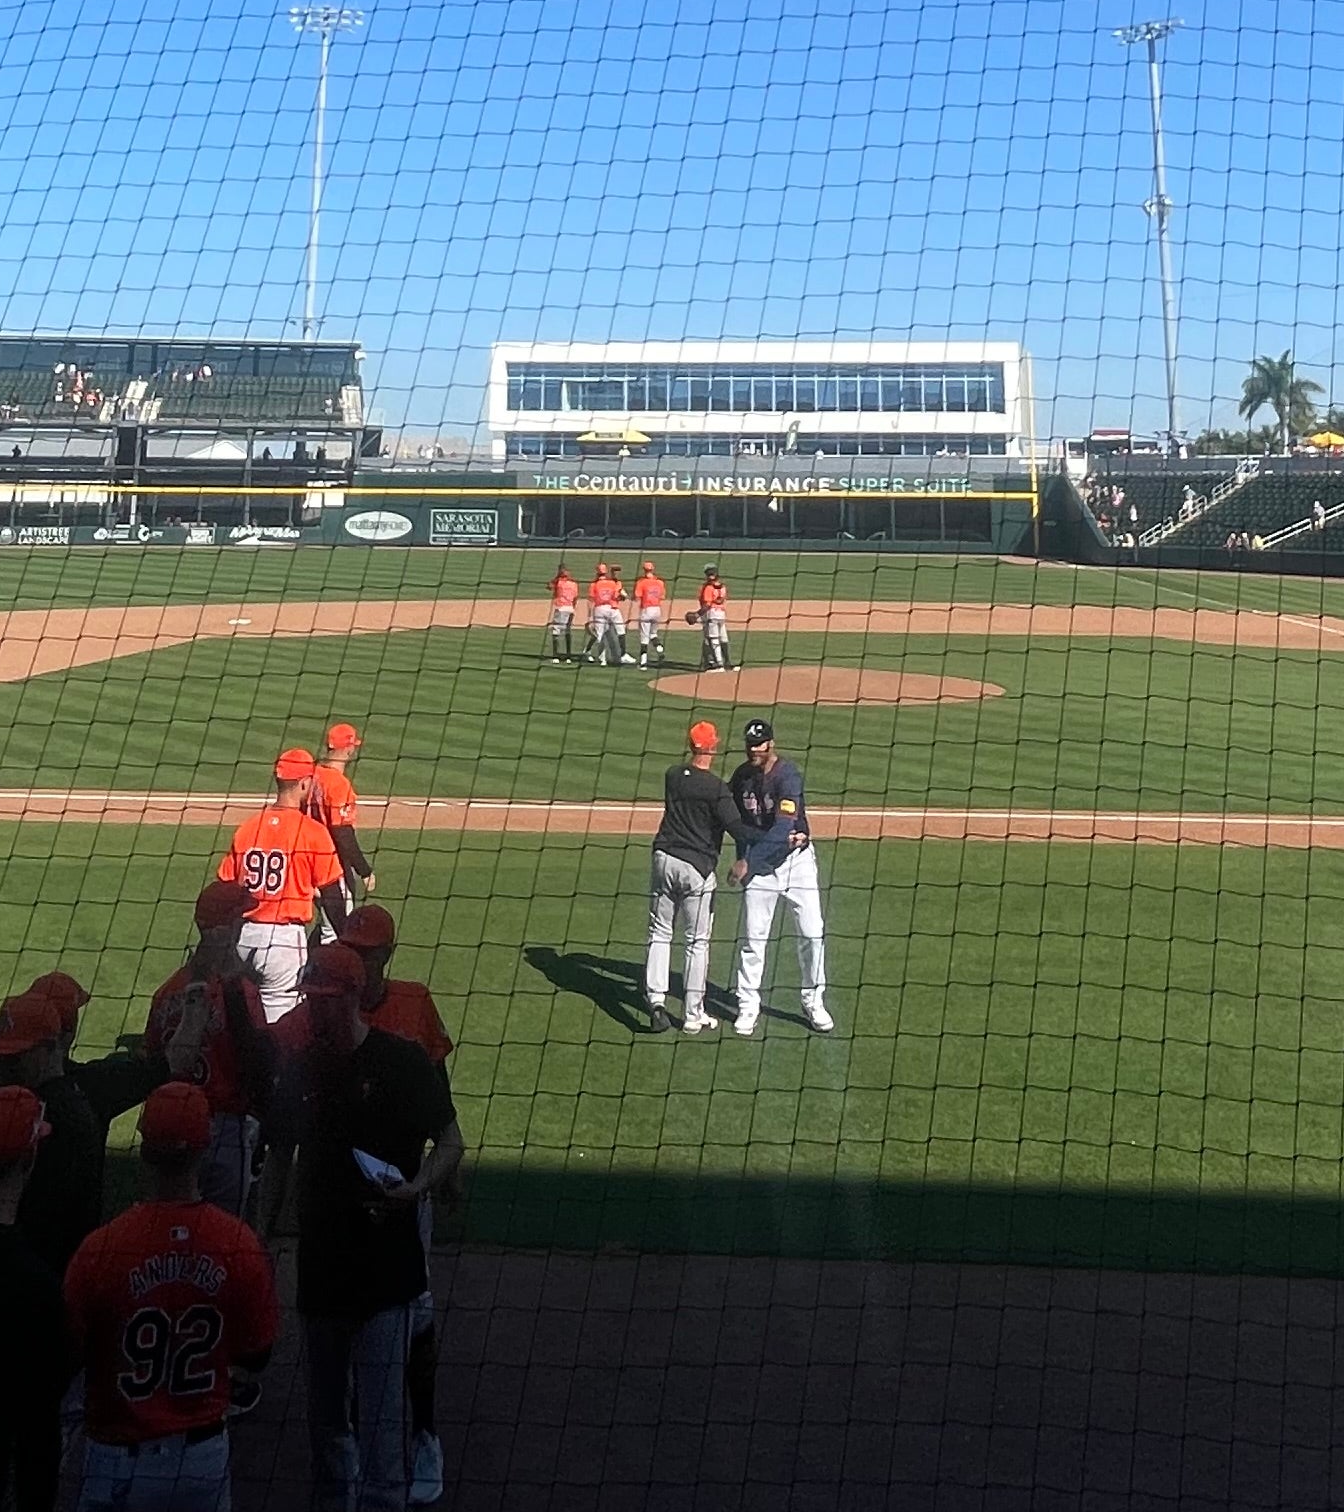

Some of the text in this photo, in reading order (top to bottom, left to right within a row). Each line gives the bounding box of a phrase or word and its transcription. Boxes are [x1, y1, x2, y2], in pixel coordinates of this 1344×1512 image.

[532, 474, 570, 489] THE
[573, 471, 678, 492] Centauri
[698, 476, 831, 492] INSURANCE
[838, 477, 906, 493] SUPER
[434, 522, 492, 533] MEMORIAL
[435, 513, 493, 524] SARASOTA
[243, 847, 288, 895] 98
[117, 1304, 224, 1401] 92
